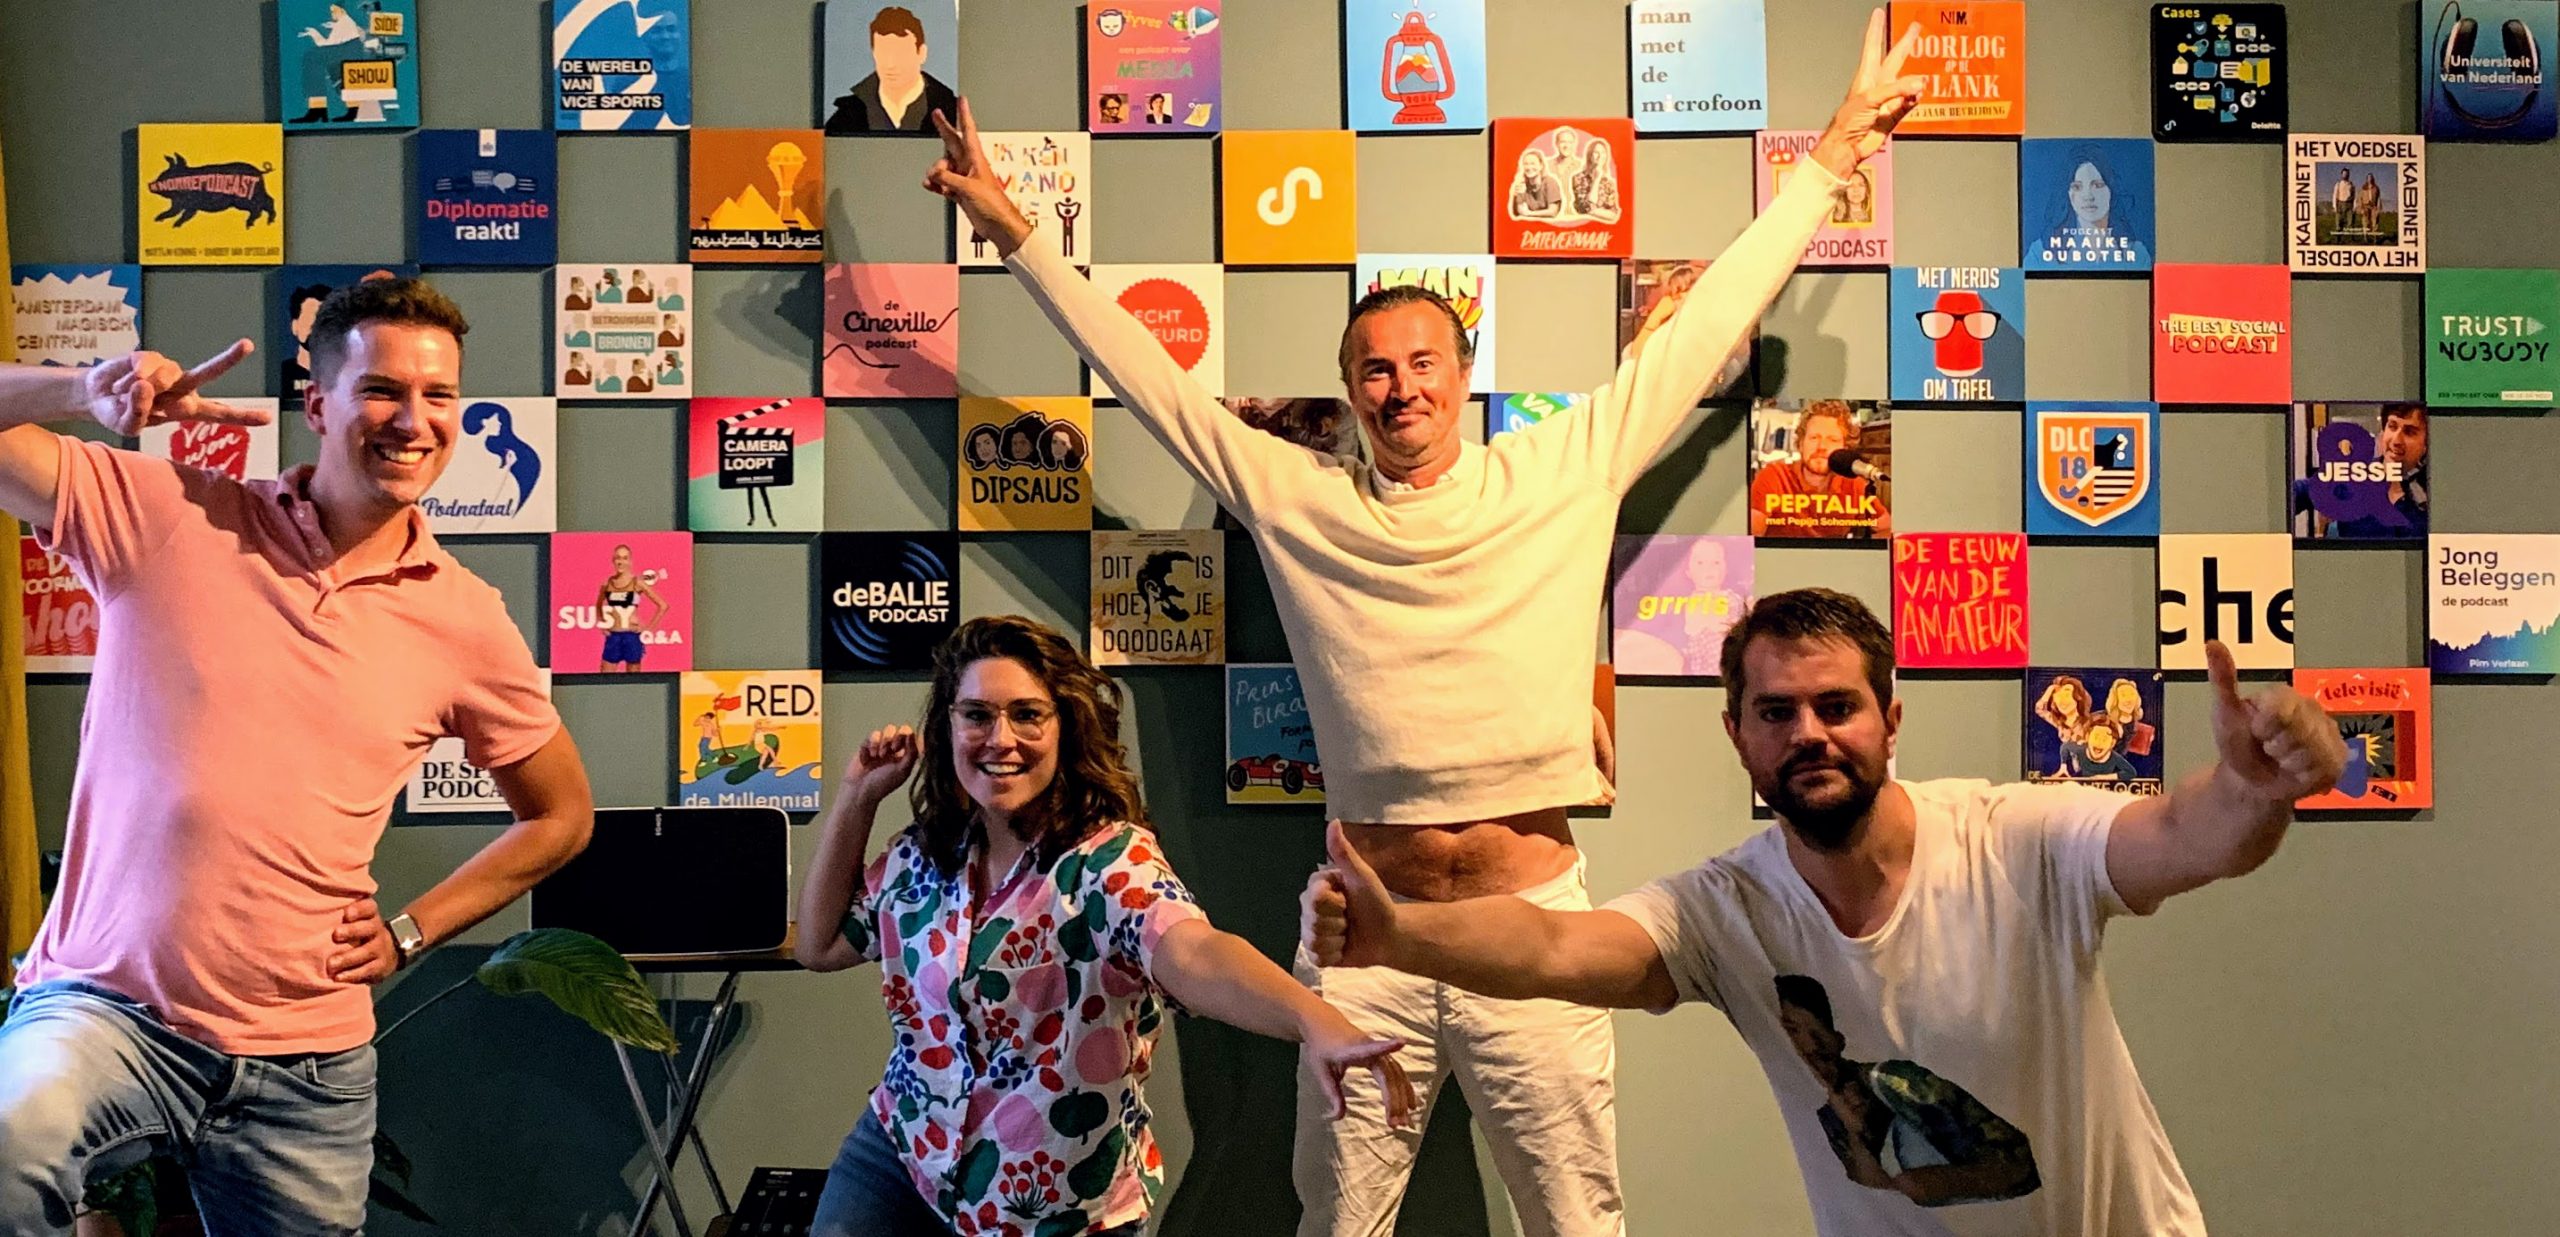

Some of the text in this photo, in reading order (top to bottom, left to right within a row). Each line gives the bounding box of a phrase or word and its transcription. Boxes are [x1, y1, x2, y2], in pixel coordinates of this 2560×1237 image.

[1640, 11, 1691, 24] man
[2161, 7, 2200, 18] Cases
[374, 17, 398, 32] SIDE
[1641, 40, 1686, 53] met
[1909, 35, 2005, 58] OORLOG
[561, 60, 652, 73] DE WERELD
[2450, 55, 2531, 68] Universiteit
[348, 68, 389, 84] SHOW
[1641, 66, 1668, 83] de
[2440, 71, 2543, 84] van Nederland
[561, 78, 593, 91] VAN
[561, 95, 662, 108] VICE SPORTS
[1641, 93, 1762, 112] microfoon
[2296, 141, 2418, 158] HET VOEDSEL
[427, 199, 549, 222] Diplomatie
[2296, 161, 2311, 246] KABINET
[2403, 162, 2419, 247] KABINET
[456, 221, 520, 240] raakt!
[1805, 240, 1888, 258] PODCAST
[2050, 237, 2129, 248] MAAIKE
[2042, 250, 2136, 262] OUBOTER
[2297, 250, 2418, 267] HET VOEDSEL
[1917, 267, 2000, 288] MET NERDS
[16, 300, 122, 315] AMSTERDAM
[884, 301, 900, 310] de
[57, 318, 133, 331] MAGISCH
[843, 311, 940, 333] Cineville
[2160, 320, 2286, 334] THE BEST SOCIAL
[2442, 315, 2524, 336] TRUST
[16, 335, 97, 349] CENTRUM
[865, 339, 918, 350] podcast
[2172, 335, 2275, 353] PODCAST
[2439, 341, 2549, 362] NOBODY
[1923, 379, 1995, 401] OM TAFEL
[724, 440, 788, 452] CAMERA
[2050, 426, 2091, 453] DLC
[724, 458, 775, 471] LOOPT
[2060, 457, 2087, 479] 18
[2318, 462, 2403, 482] JESSE
[972, 476, 1080, 504] DIPSAUS
[1765, 494, 1877, 514] PEPTALK
[1766, 518, 1785, 526] met
[1820, 517, 1877, 527] Schoneveld
[1894, 536, 2020, 564] DE EEUW
[2440, 547, 2498, 569] Jong
[1102, 556, 1214, 579] DIT IS
[1898, 566, 2012, 601] VAN DE
[2441, 568, 2556, 590] Beleggen
[833, 581, 950, 607] deBALIE
[2442, 597, 2509, 608] de podcast
[1102, 593, 1214, 616] HOE JE
[557, 605, 637, 629] SUSY
[869, 608, 949, 622] PODCAST
[639, 630, 682, 644] Q&A
[1901, 599, 2027, 658] AMATEUR
[1103, 628, 1215, 653] DOODGAAT
[2469, 659, 2529, 668] Pim Verlaan
[746, 684, 819, 716] RED.
[422, 762, 464, 779] DE
[423, 780, 502, 799] PODCA
[684, 791, 820, 807] de Millennial
